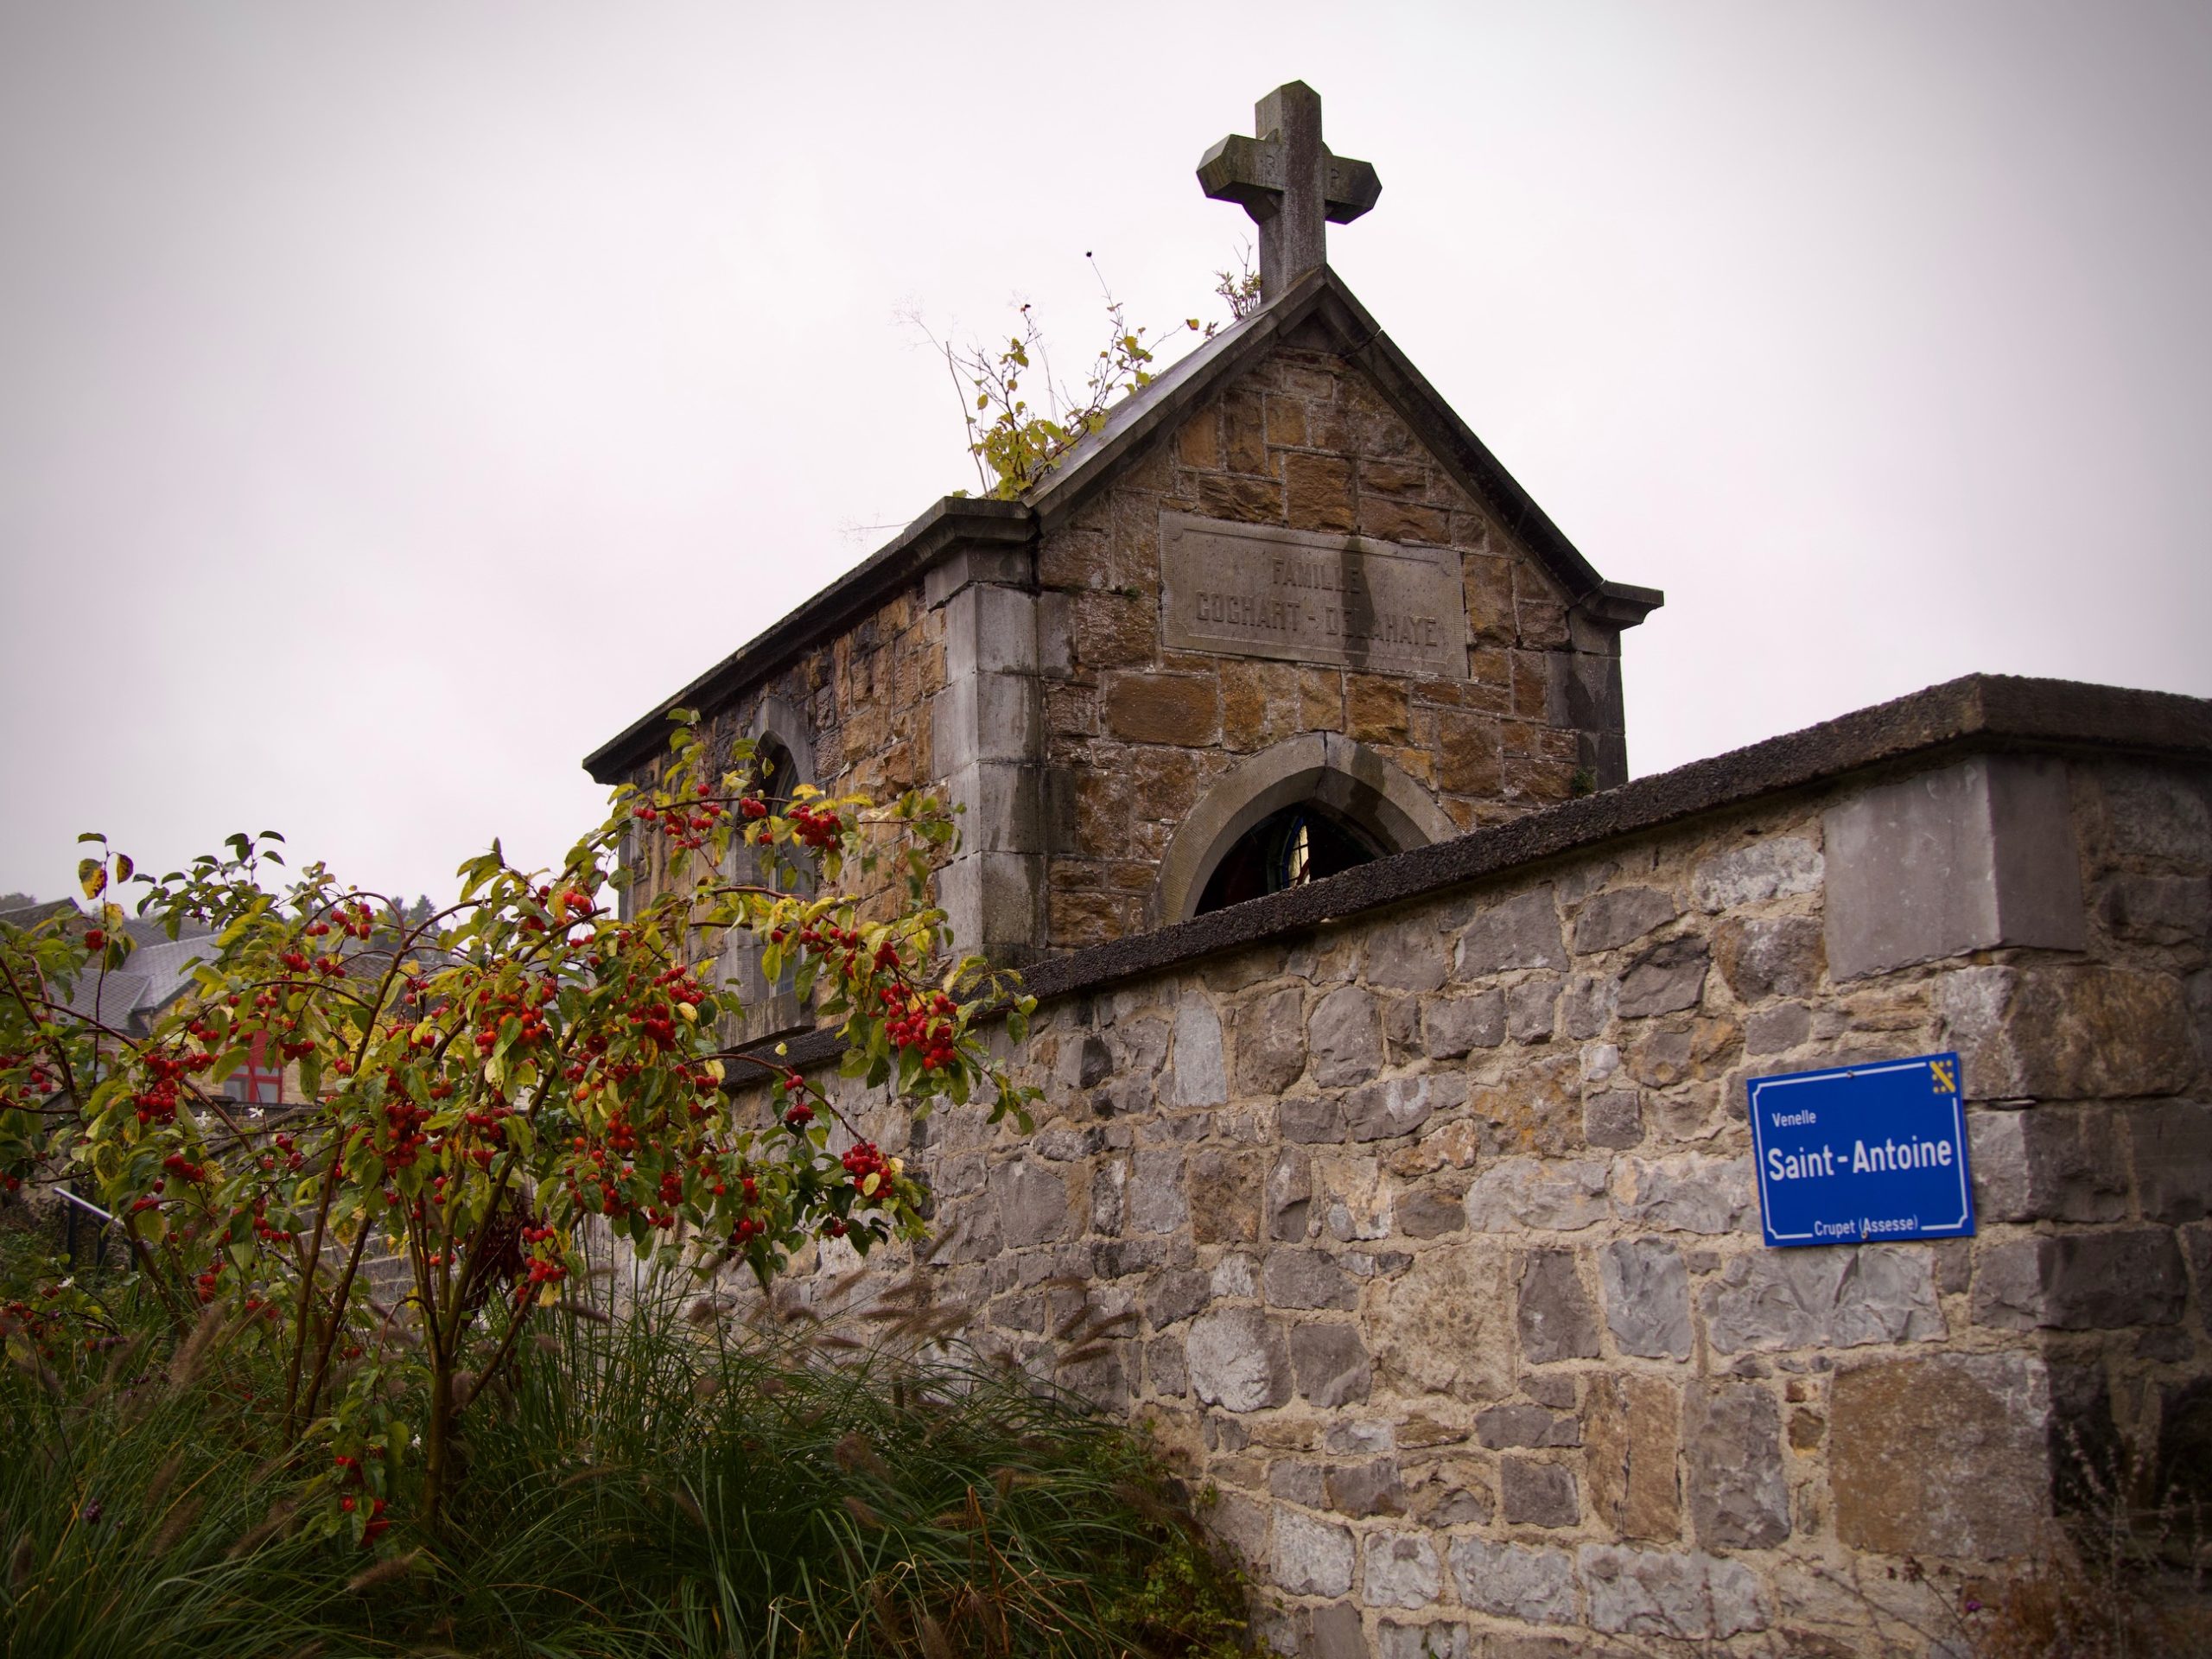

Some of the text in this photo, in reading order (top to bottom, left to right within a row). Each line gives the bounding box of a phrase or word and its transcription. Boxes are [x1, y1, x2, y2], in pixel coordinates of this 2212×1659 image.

[1272, 557, 1360, 594] FAMILLE
[1196, 589, 1300, 632] COCHART
[1771, 1109, 1816, 1128] Venelle
[1767, 1135, 1953, 1181] Saint-Antoine
[1814, 1214, 1918, 1238] Crupet (Assesse)
